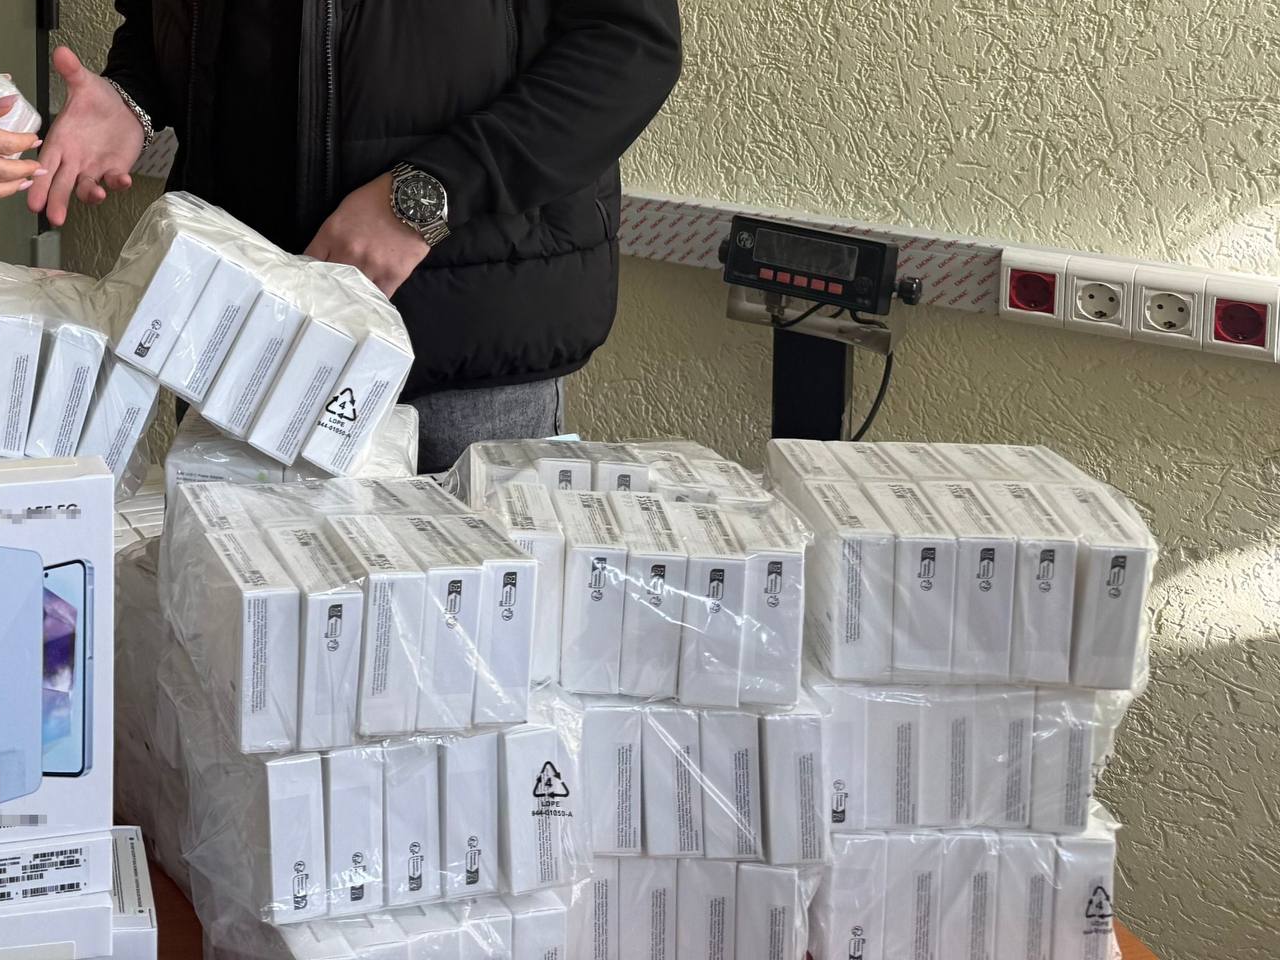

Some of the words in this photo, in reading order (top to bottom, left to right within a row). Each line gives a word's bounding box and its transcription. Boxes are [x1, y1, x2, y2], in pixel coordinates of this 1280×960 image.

[338, 401, 347, 410] 4
[328, 417, 346, 428] LDPE
[544, 777, 554, 788] 4
[541, 800, 561, 808] LDPE
